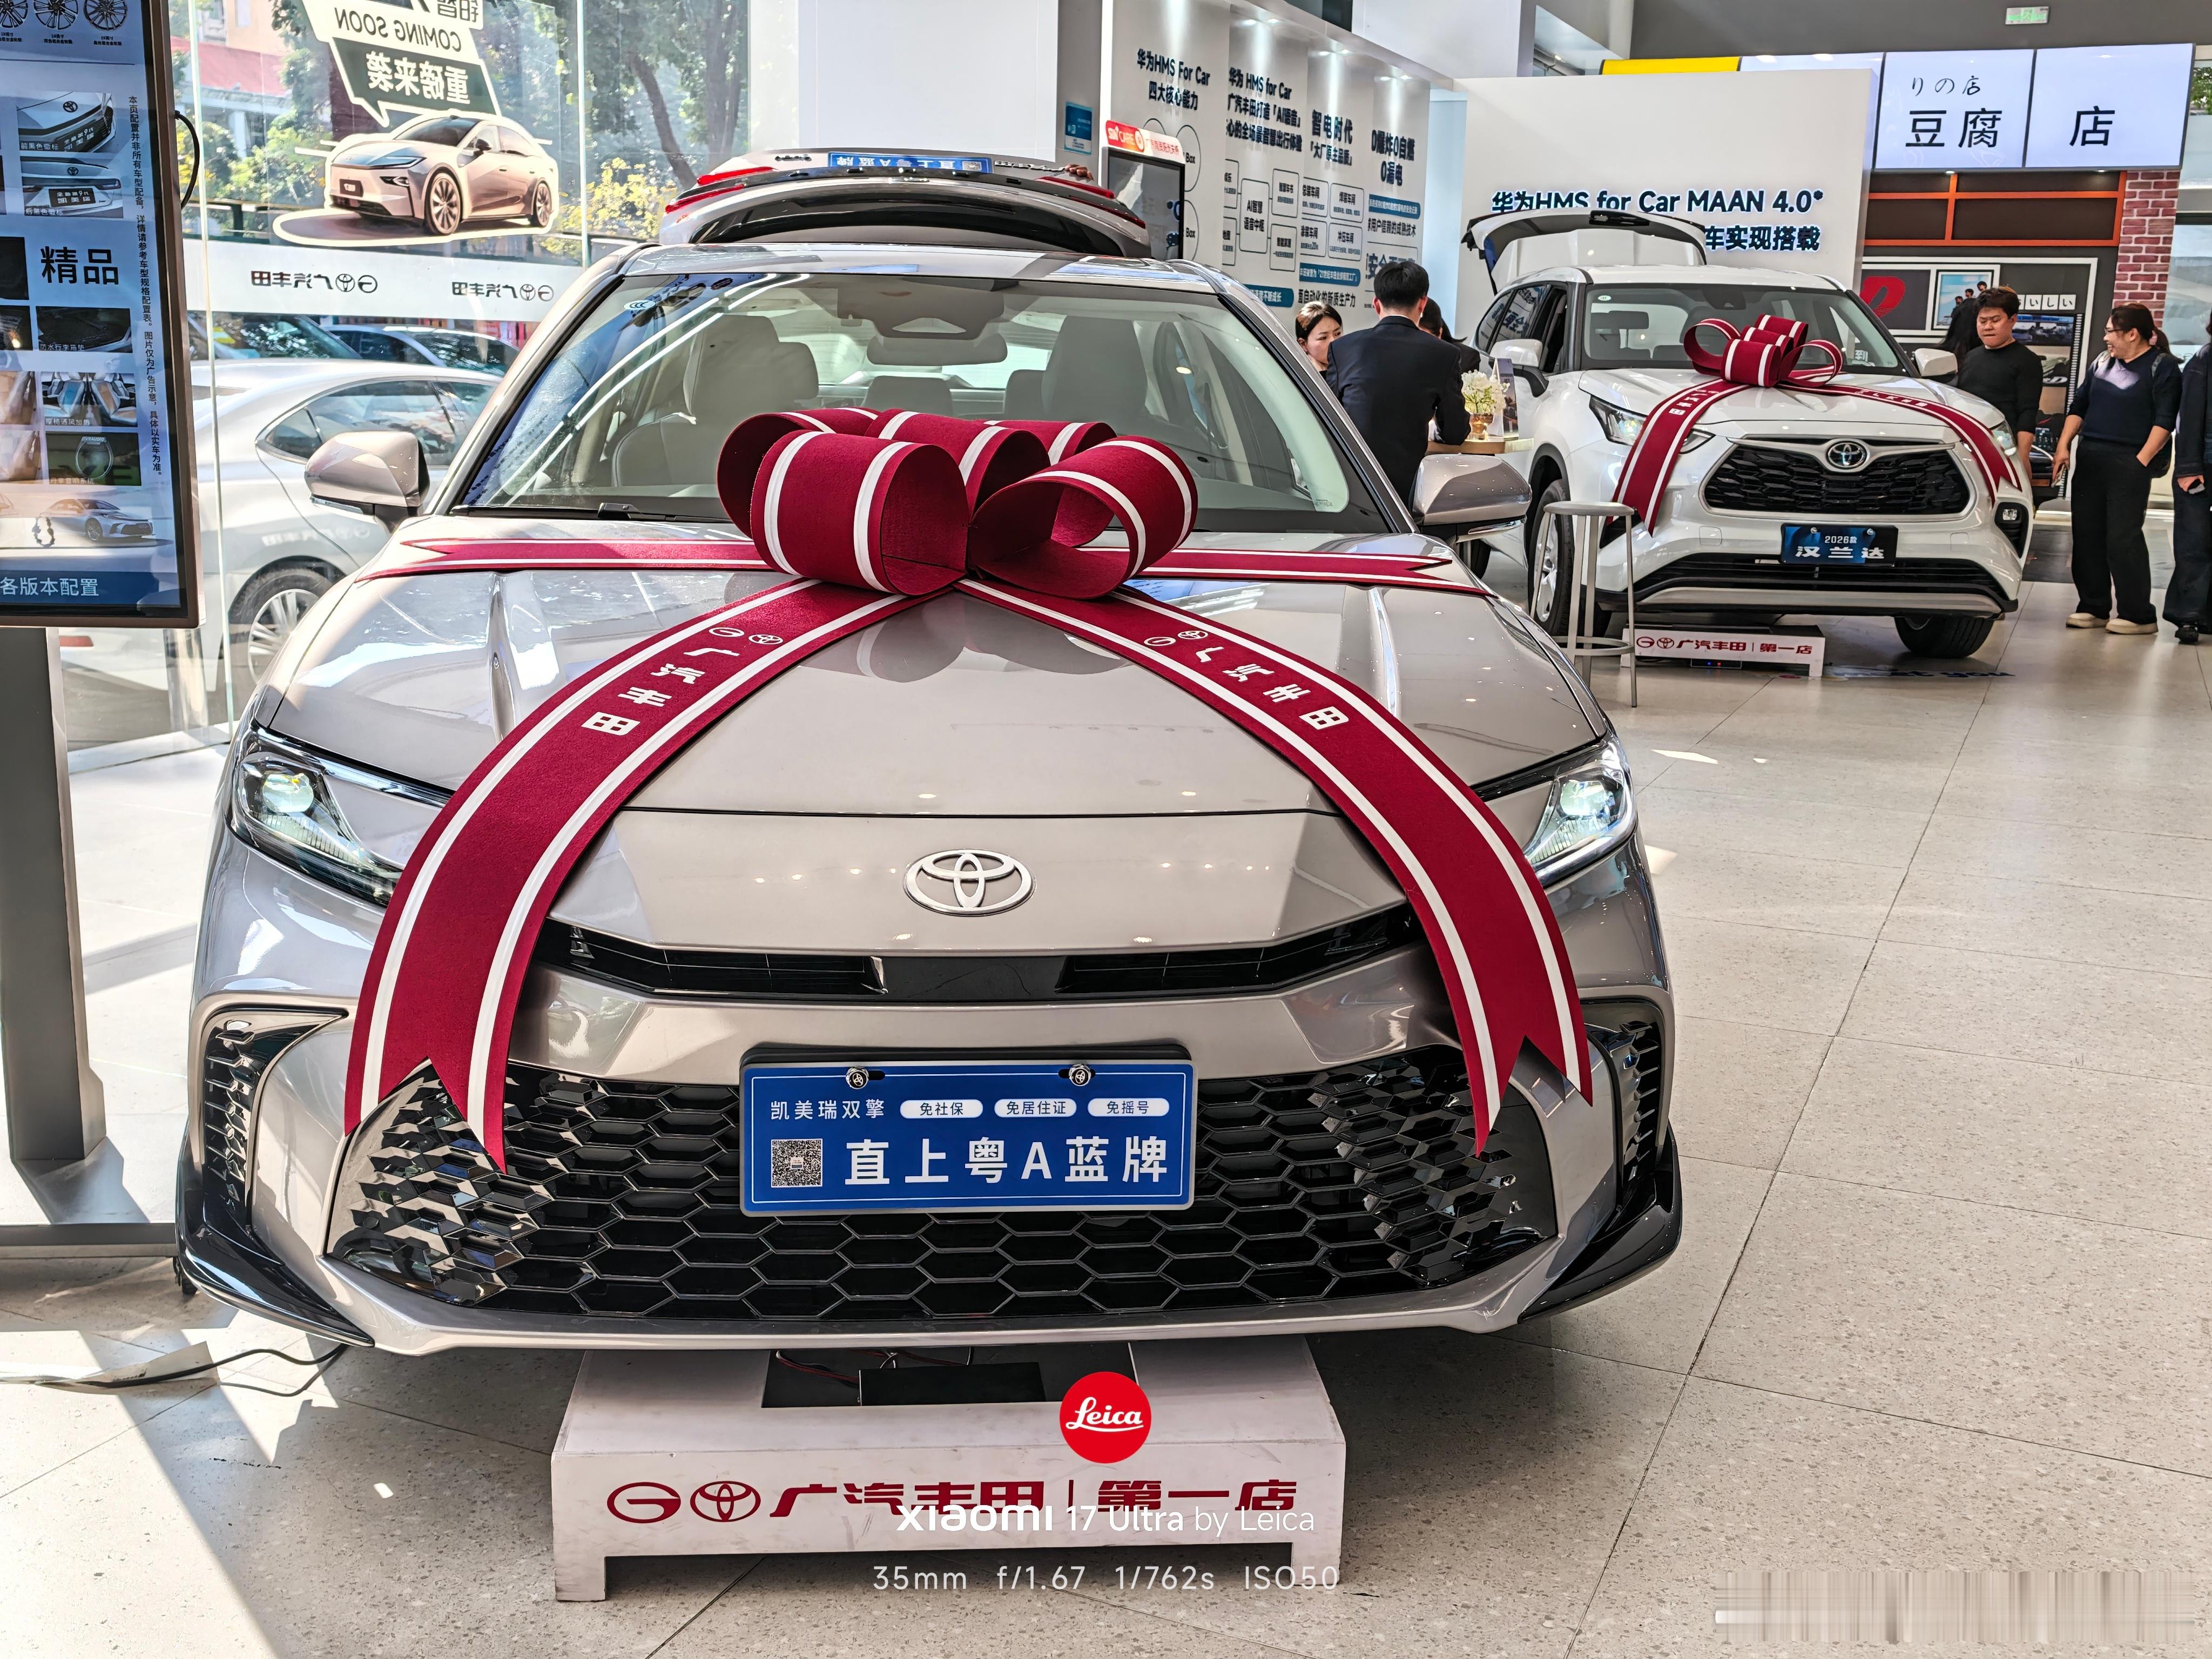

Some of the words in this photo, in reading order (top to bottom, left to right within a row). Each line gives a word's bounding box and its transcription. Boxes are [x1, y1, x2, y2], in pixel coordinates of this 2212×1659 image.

[1137, 48, 1175, 76] 华为HMS
[1178, 60, 1193, 81] For
[1195, 66, 1211, 86] Car
[1149, 80, 1198, 111] 四大核心能力
[1246, 72, 1264, 92] HMS
[1266, 77, 1277, 96] for
[1279, 82, 1292, 100] Car
[1912, 76, 1980, 96] りの店
[1226, 118, 1303, 152] 心的全场景智慧出行体验
[1312, 110, 1353, 144] 智电时代
[1905, 107, 2002, 148] 豆腐
[2070, 106, 2115, 146] 店
[1492, 191, 1589, 213] 华为HMS
[1597, 191, 1632, 210] for
[1640, 191, 1680, 213] Car
[1688, 191, 1764, 212] MAAN
[1705, 226, 1821, 251] 车实现搭载
[41, 246, 119, 285] 精品
[2019, 297, 2073, 307] いしい
[1795, 546, 1884, 558] 汉兰达
[1825, 536, 1857, 544] 2026款
[0, 577, 99, 597] 各版本配置
[1676, 639, 1747, 652] 广汽丰田
[1759, 643, 1812, 654] 第一店
[581, 648, 740, 736] 广汽丰田
[1195, 646, 1349, 730] 广汽丰田
[771, 1099, 885, 1120] 凯美瑞双擎
[920, 1102, 964, 1116] 免社保
[1007, 1101, 1067, 1115] 免居住证
[1106, 1101, 1149, 1115] 免摇号
[845, 1136, 1167, 1185] 直上粤A蓝牌
[770, 1481, 1044, 1517] 广汽丰田
[1097, 1480, 1297, 1512] 第一店
